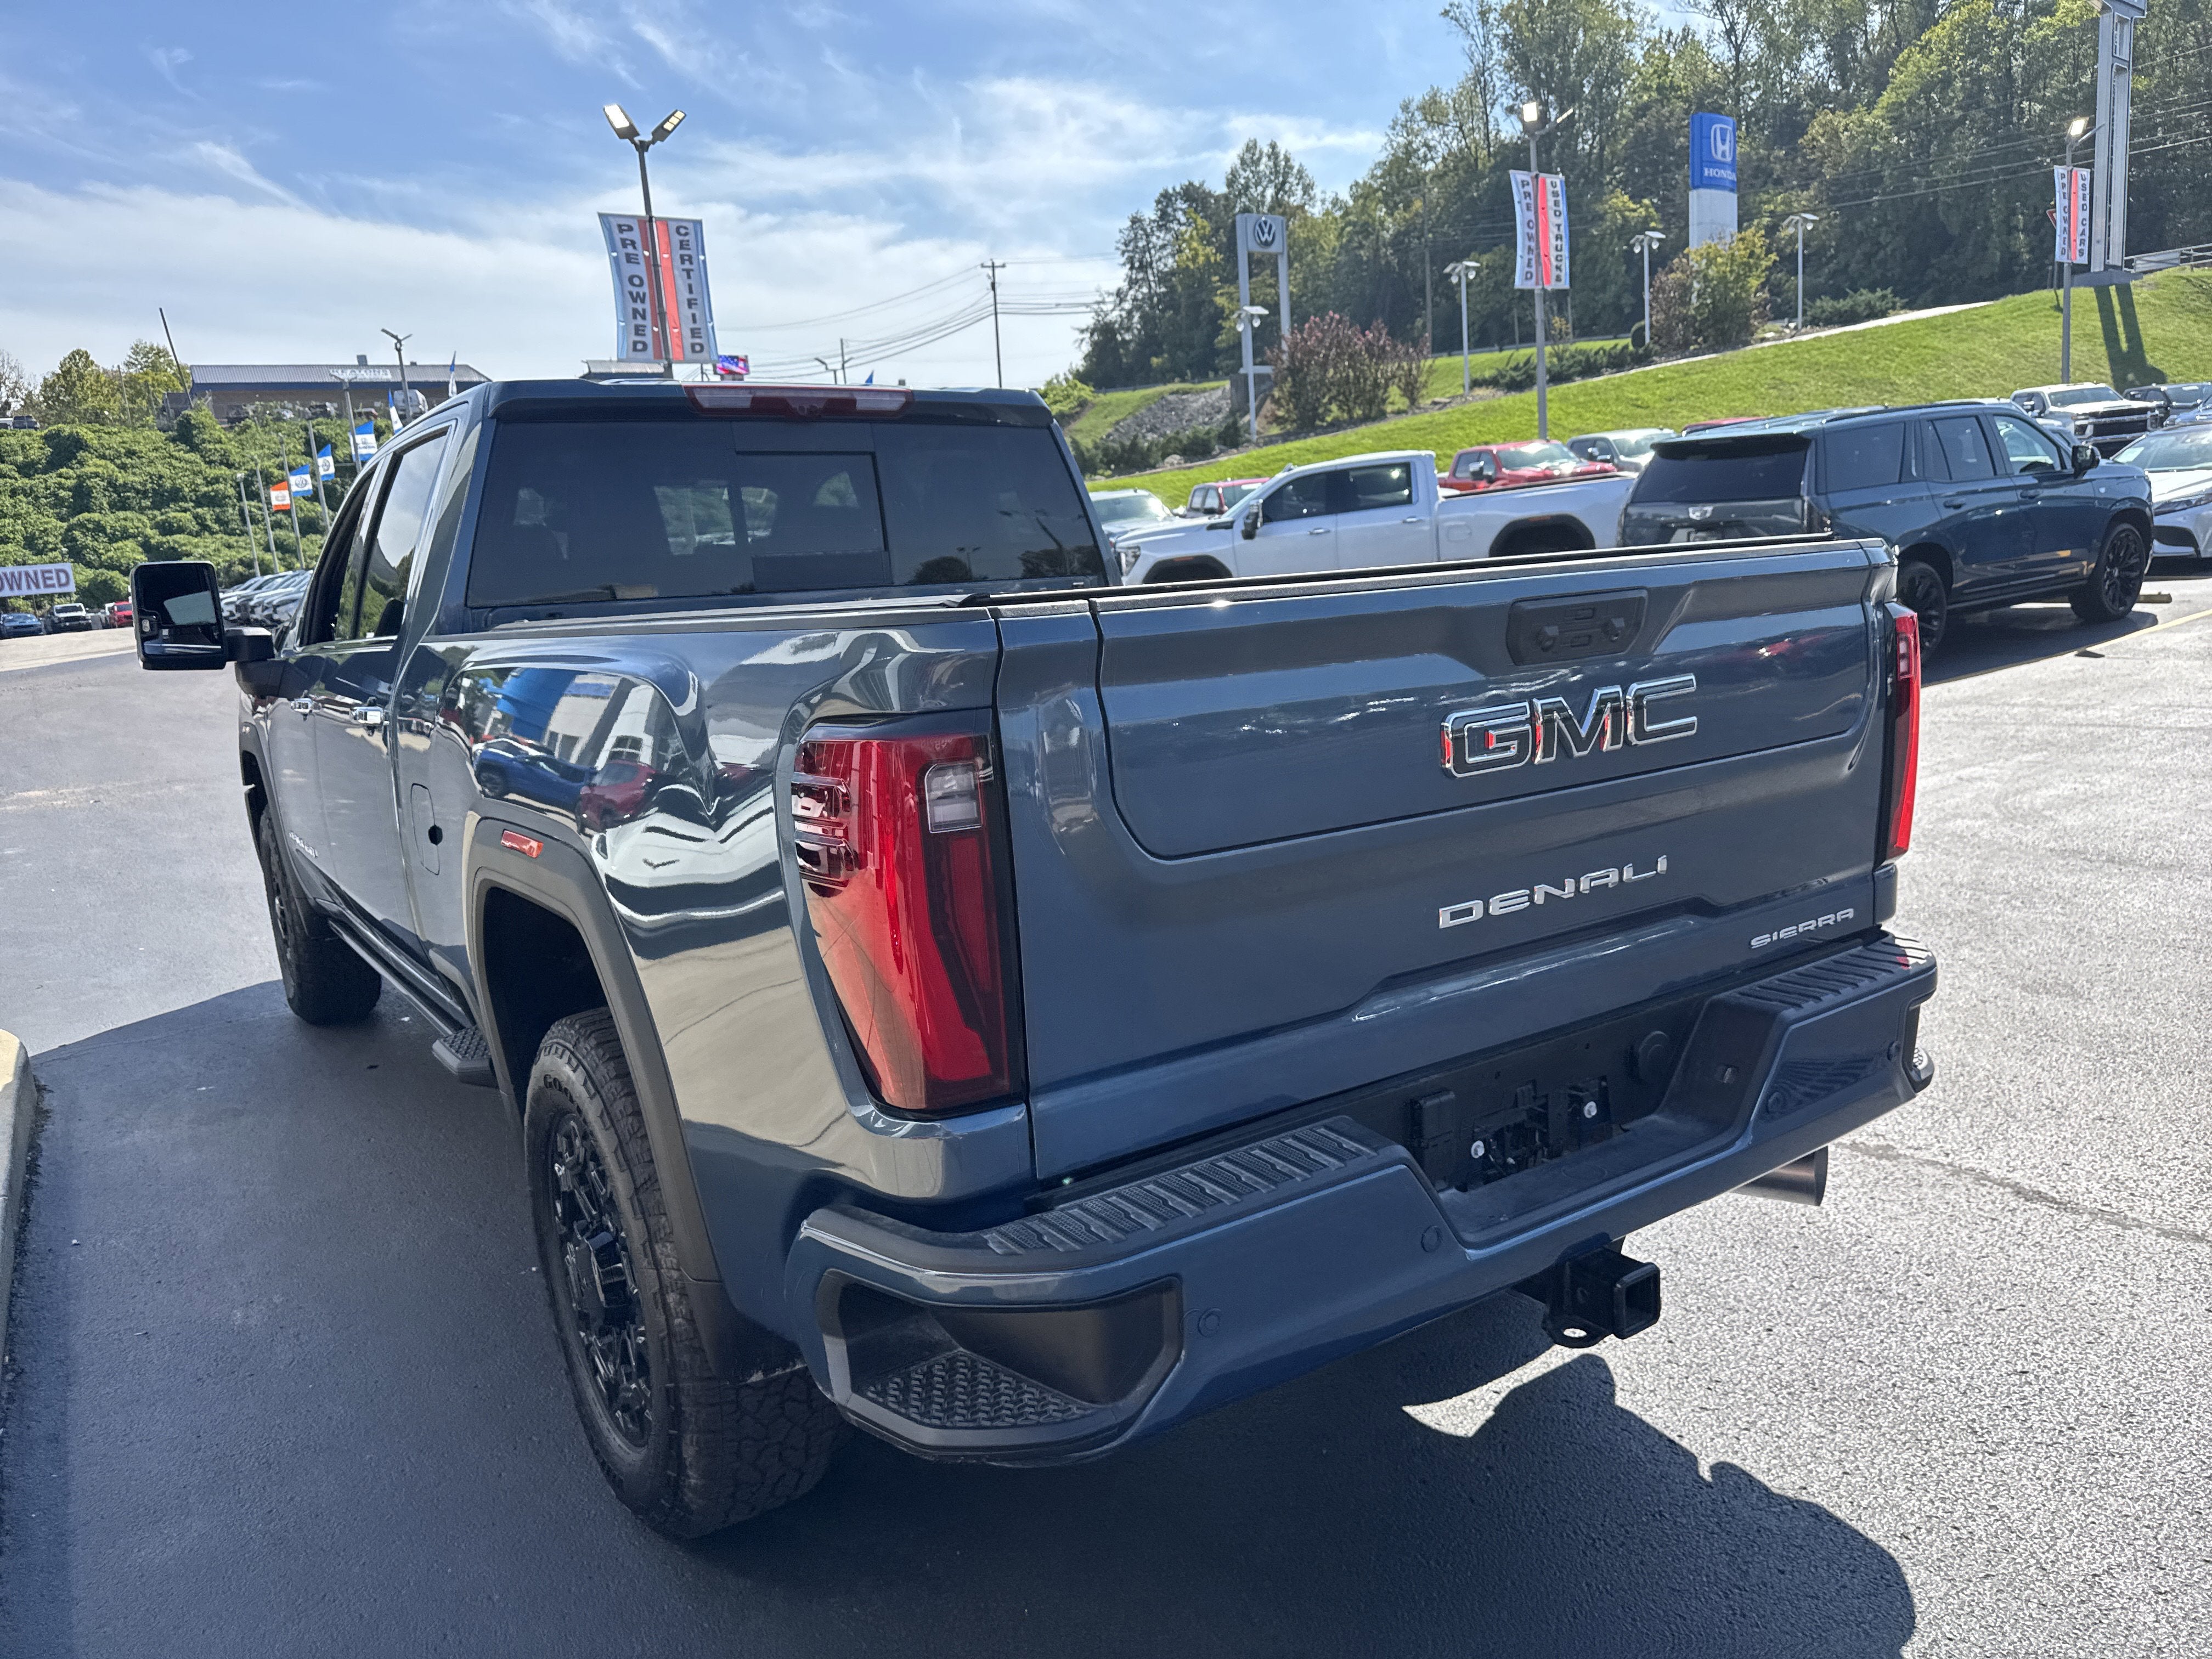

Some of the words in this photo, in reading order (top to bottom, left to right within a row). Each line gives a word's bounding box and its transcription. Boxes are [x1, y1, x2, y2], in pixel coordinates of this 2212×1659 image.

[1521, 180, 1532, 211] PRE
[1551, 180, 1562, 217] USED
[617, 223, 640, 264] PRE
[1525, 219, 1534, 281] OWNED
[1555, 224, 1563, 282] TRUCKS
[2078, 218, 2086, 257] CARS
[628, 274, 648, 352] OWNED
[675, 225, 704, 353] CERTIFIED
[1440, 673, 1698, 778] GMC
[1438, 854, 1668, 929] DENALI
[1749, 907, 1855, 950] SIERRA
